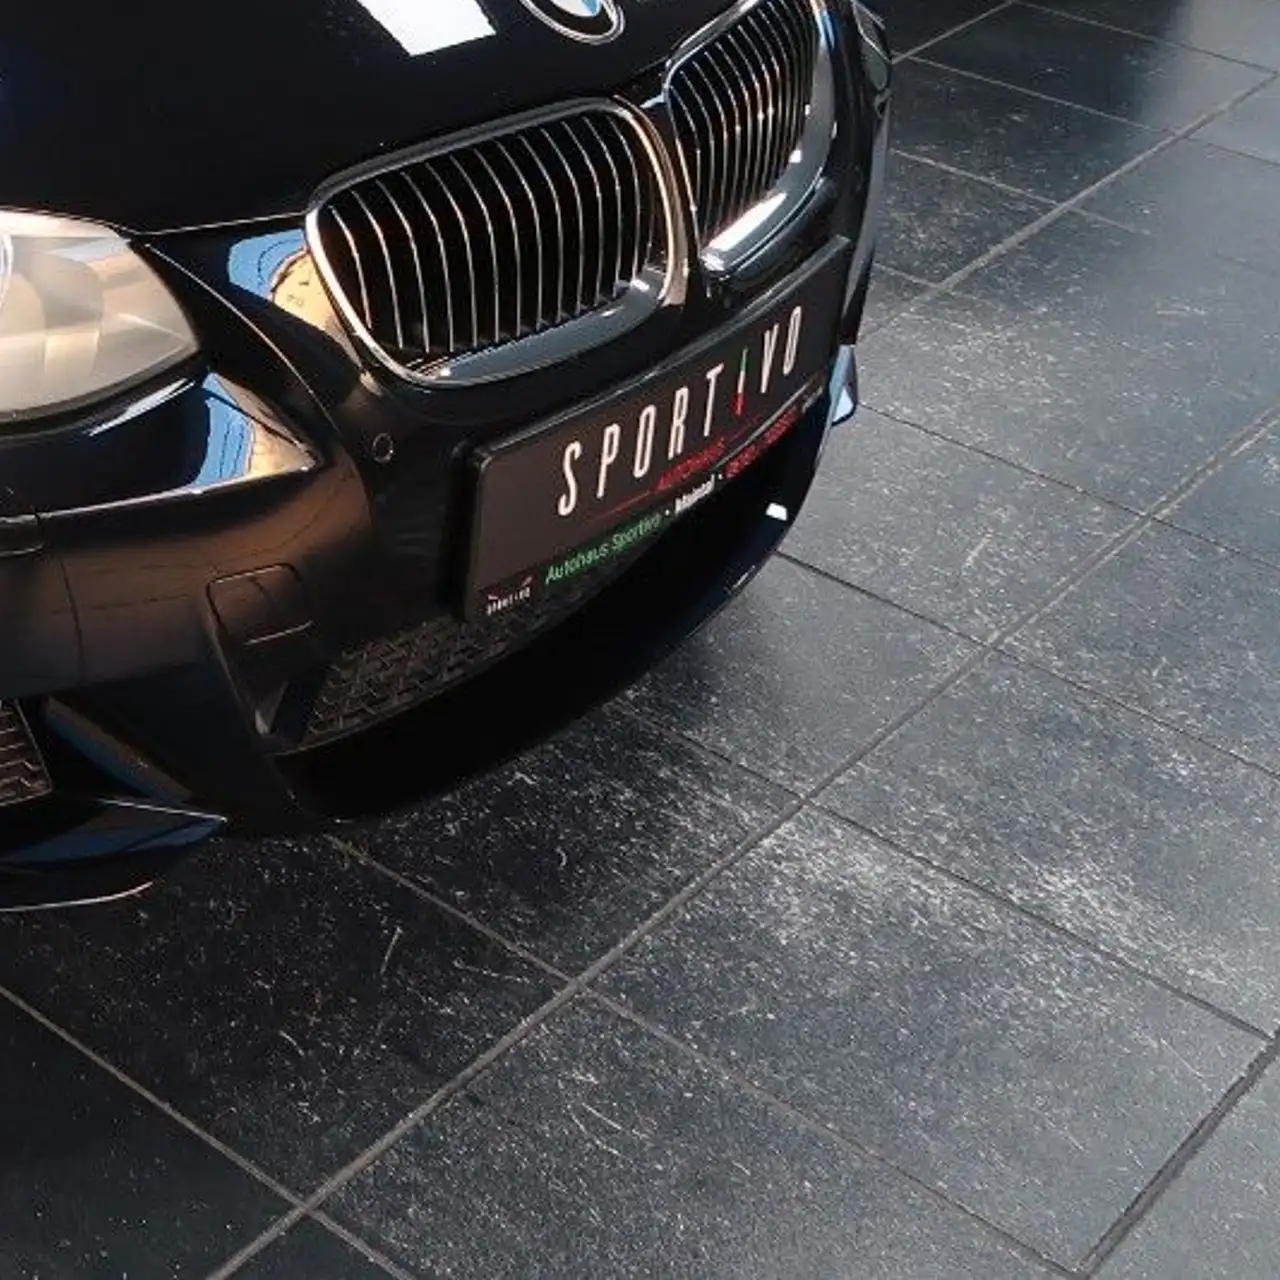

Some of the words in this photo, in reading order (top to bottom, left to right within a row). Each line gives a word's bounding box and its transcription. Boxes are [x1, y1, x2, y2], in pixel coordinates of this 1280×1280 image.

[557, 306, 802, 517] SPORTIVO
[544, 543, 610, 585] Autohaus
[611, 512, 663, 552] Sportivo
